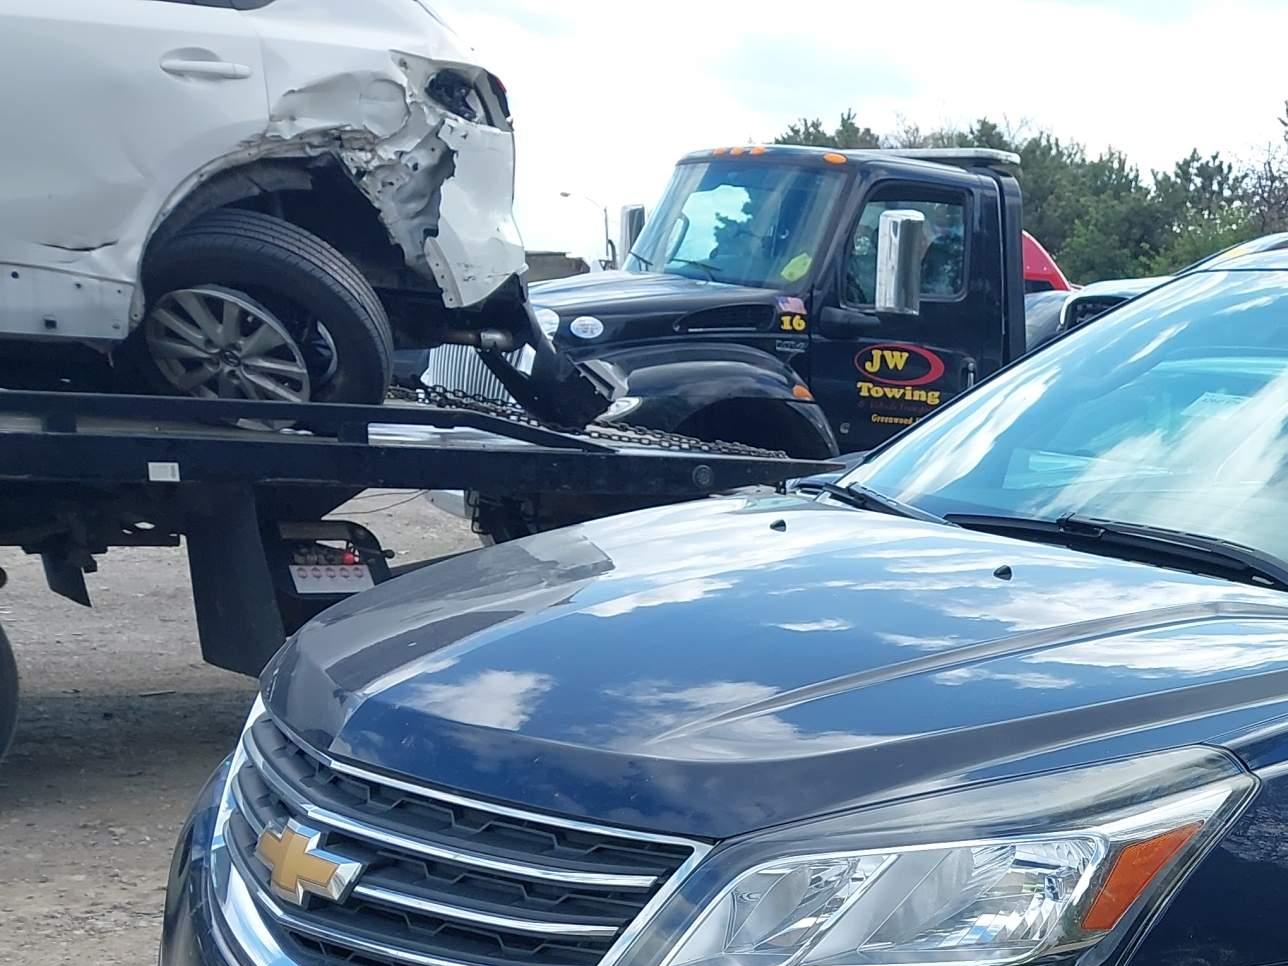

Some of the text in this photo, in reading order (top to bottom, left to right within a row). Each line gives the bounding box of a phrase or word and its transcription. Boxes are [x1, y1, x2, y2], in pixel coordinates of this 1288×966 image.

[780, 314, 806, 331] 16
[865, 349, 909, 373] JW
[856, 381, 941, 406] Towing
